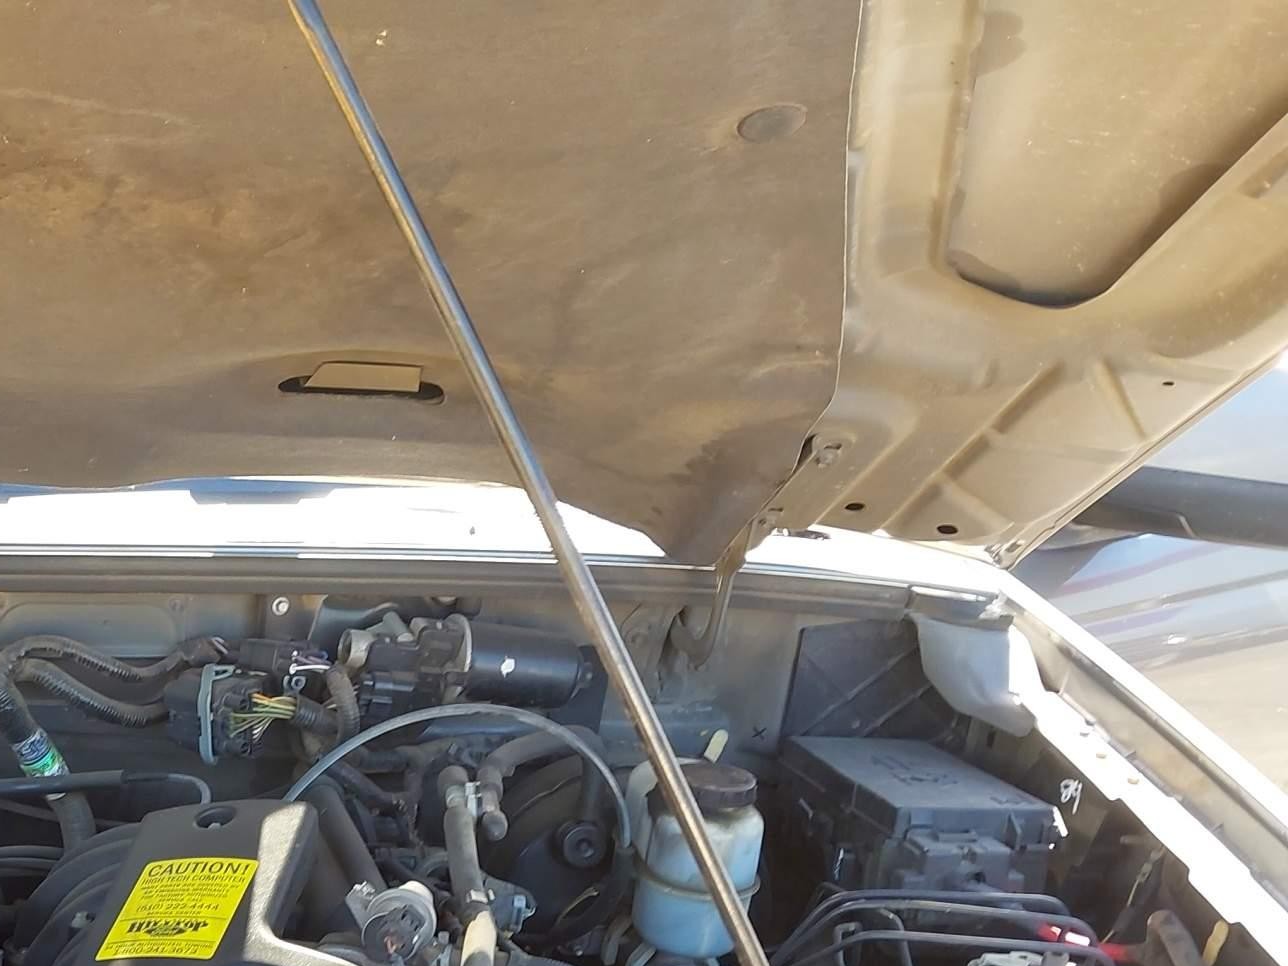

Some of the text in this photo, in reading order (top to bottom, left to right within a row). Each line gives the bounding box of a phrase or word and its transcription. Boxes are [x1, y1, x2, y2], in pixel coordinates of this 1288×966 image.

[148, 861, 249, 877] CAUTION!
[141, 876, 163, 885] HIGH
[192, 874, 245, 883] COMPUTER
